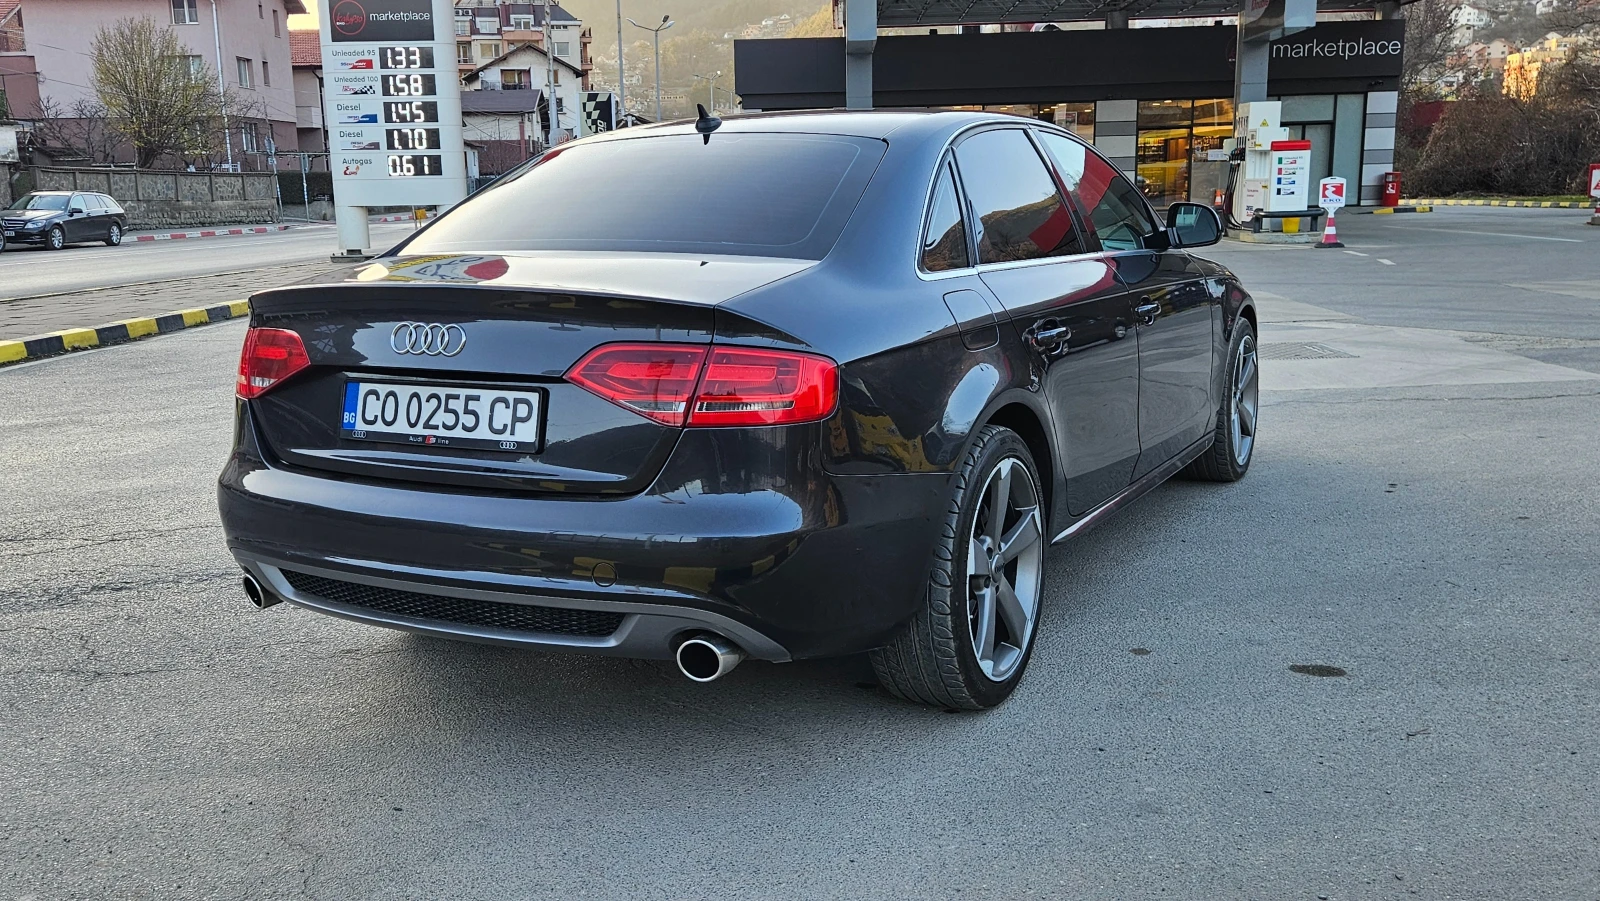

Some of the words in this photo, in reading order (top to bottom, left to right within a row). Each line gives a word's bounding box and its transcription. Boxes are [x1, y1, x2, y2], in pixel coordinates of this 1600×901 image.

[369, 11, 431, 22] marketplace
[332, 48, 365, 57] Unleaded
[1272, 37, 1401, 60] marketplace
[387, 47, 421, 69] 1.33
[389, 75, 423, 96] 1.58
[336, 103, 361, 111] Diesel
[391, 101, 425, 123] 1.45
[339, 130, 363, 138] Diesel
[393, 128, 428, 150] 1.70
[342, 158, 373, 166] Autogas
[388, 155, 430, 176] 0.61
[343, 411, 355, 423] BG
[361, 388, 400, 427] CO
[405, 391, 481, 432] 0255
[487, 396, 534, 436] CP
[409, 435, 423, 443] Audi
